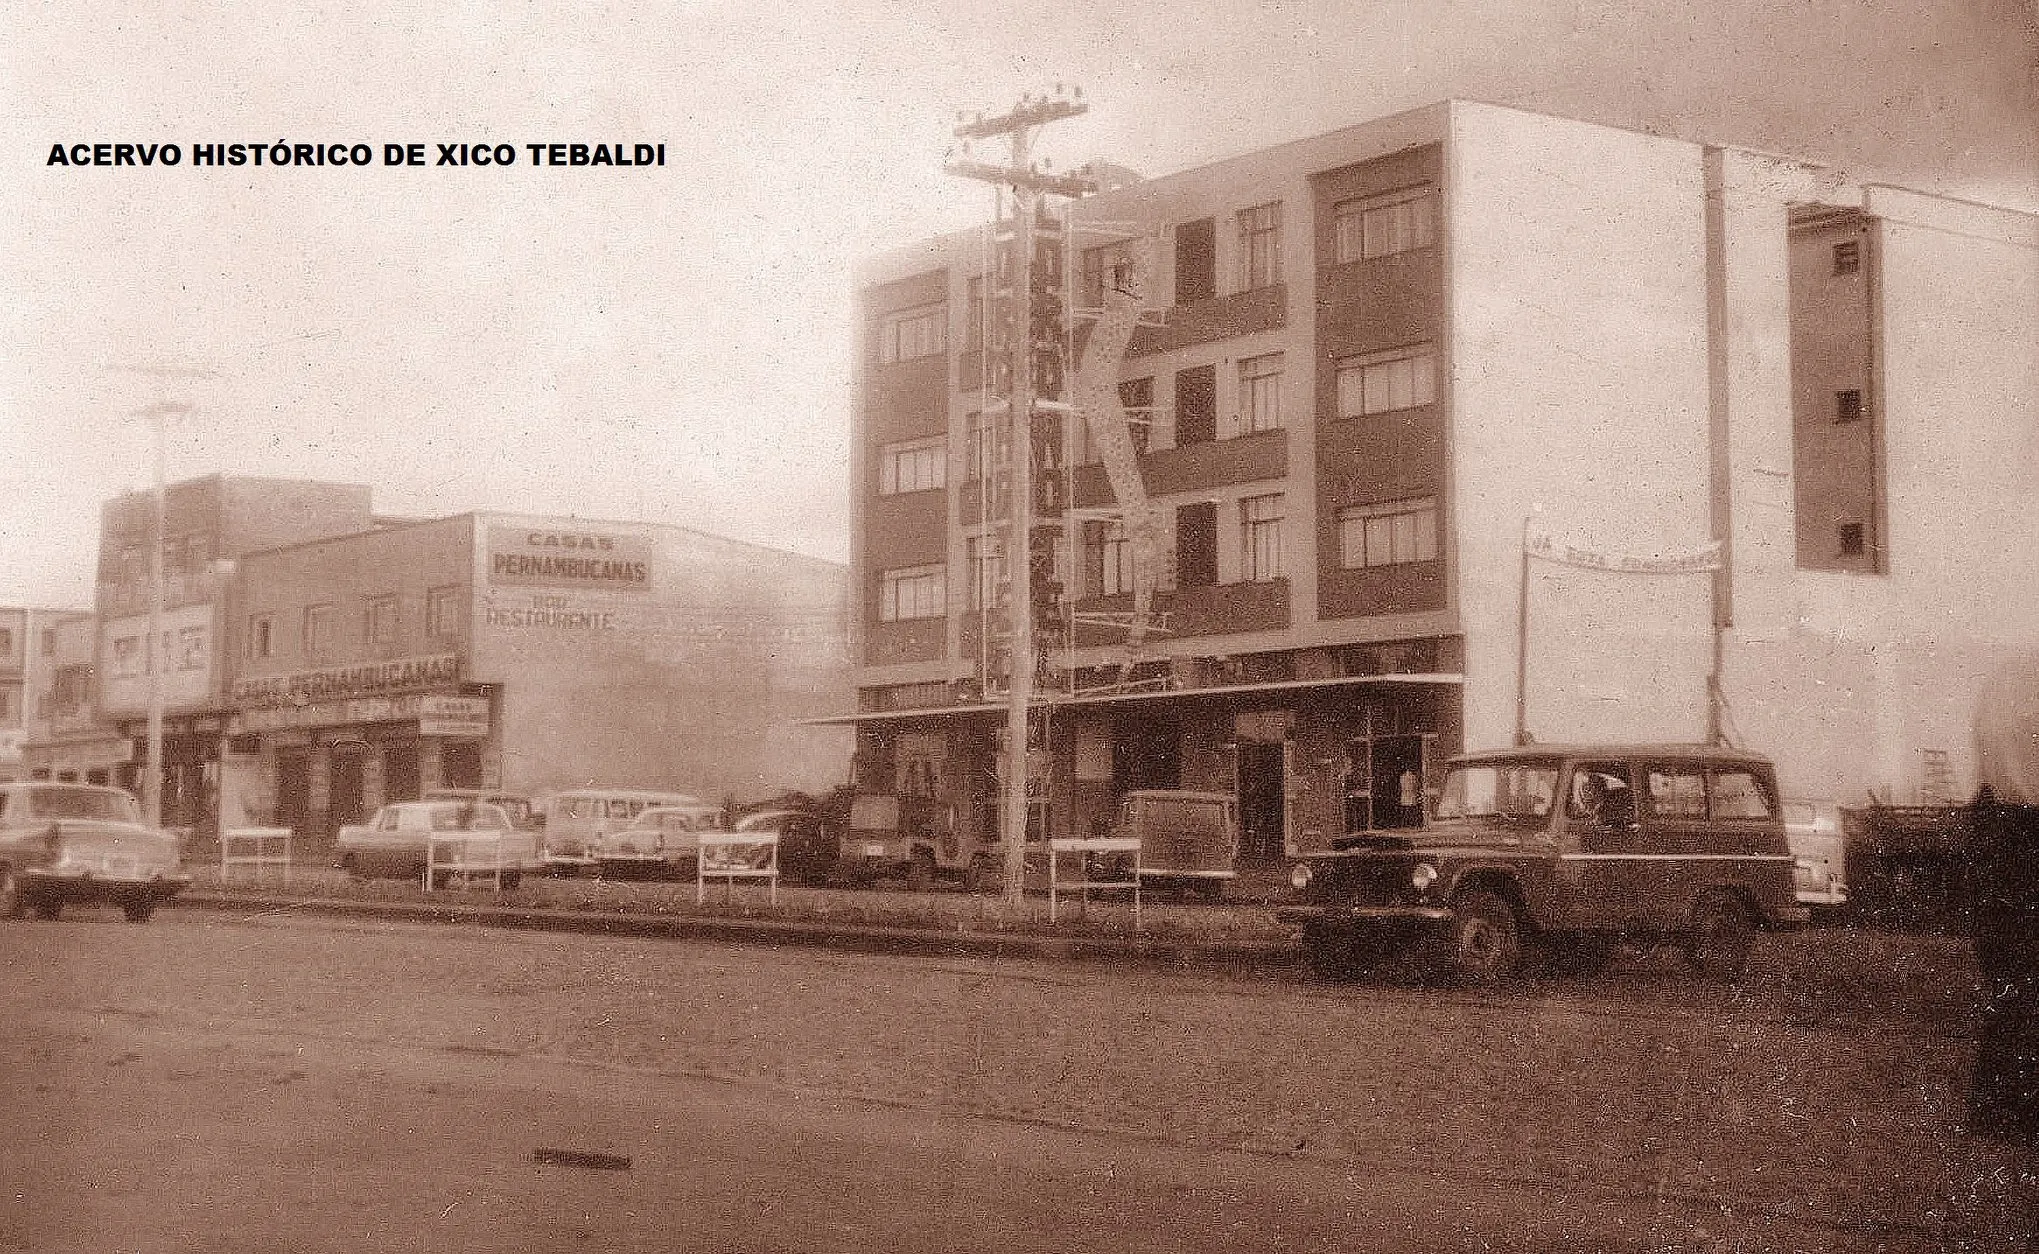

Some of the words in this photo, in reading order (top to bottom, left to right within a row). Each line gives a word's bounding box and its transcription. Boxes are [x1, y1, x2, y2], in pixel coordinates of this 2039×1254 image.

[527, 532, 614, 551] CASAS
[494, 553, 646, 582] PERNAMBUCANAS
[486, 607, 616, 631] RESTAURANTE
[289, 658, 455, 698] PERNAMBUCANAS
